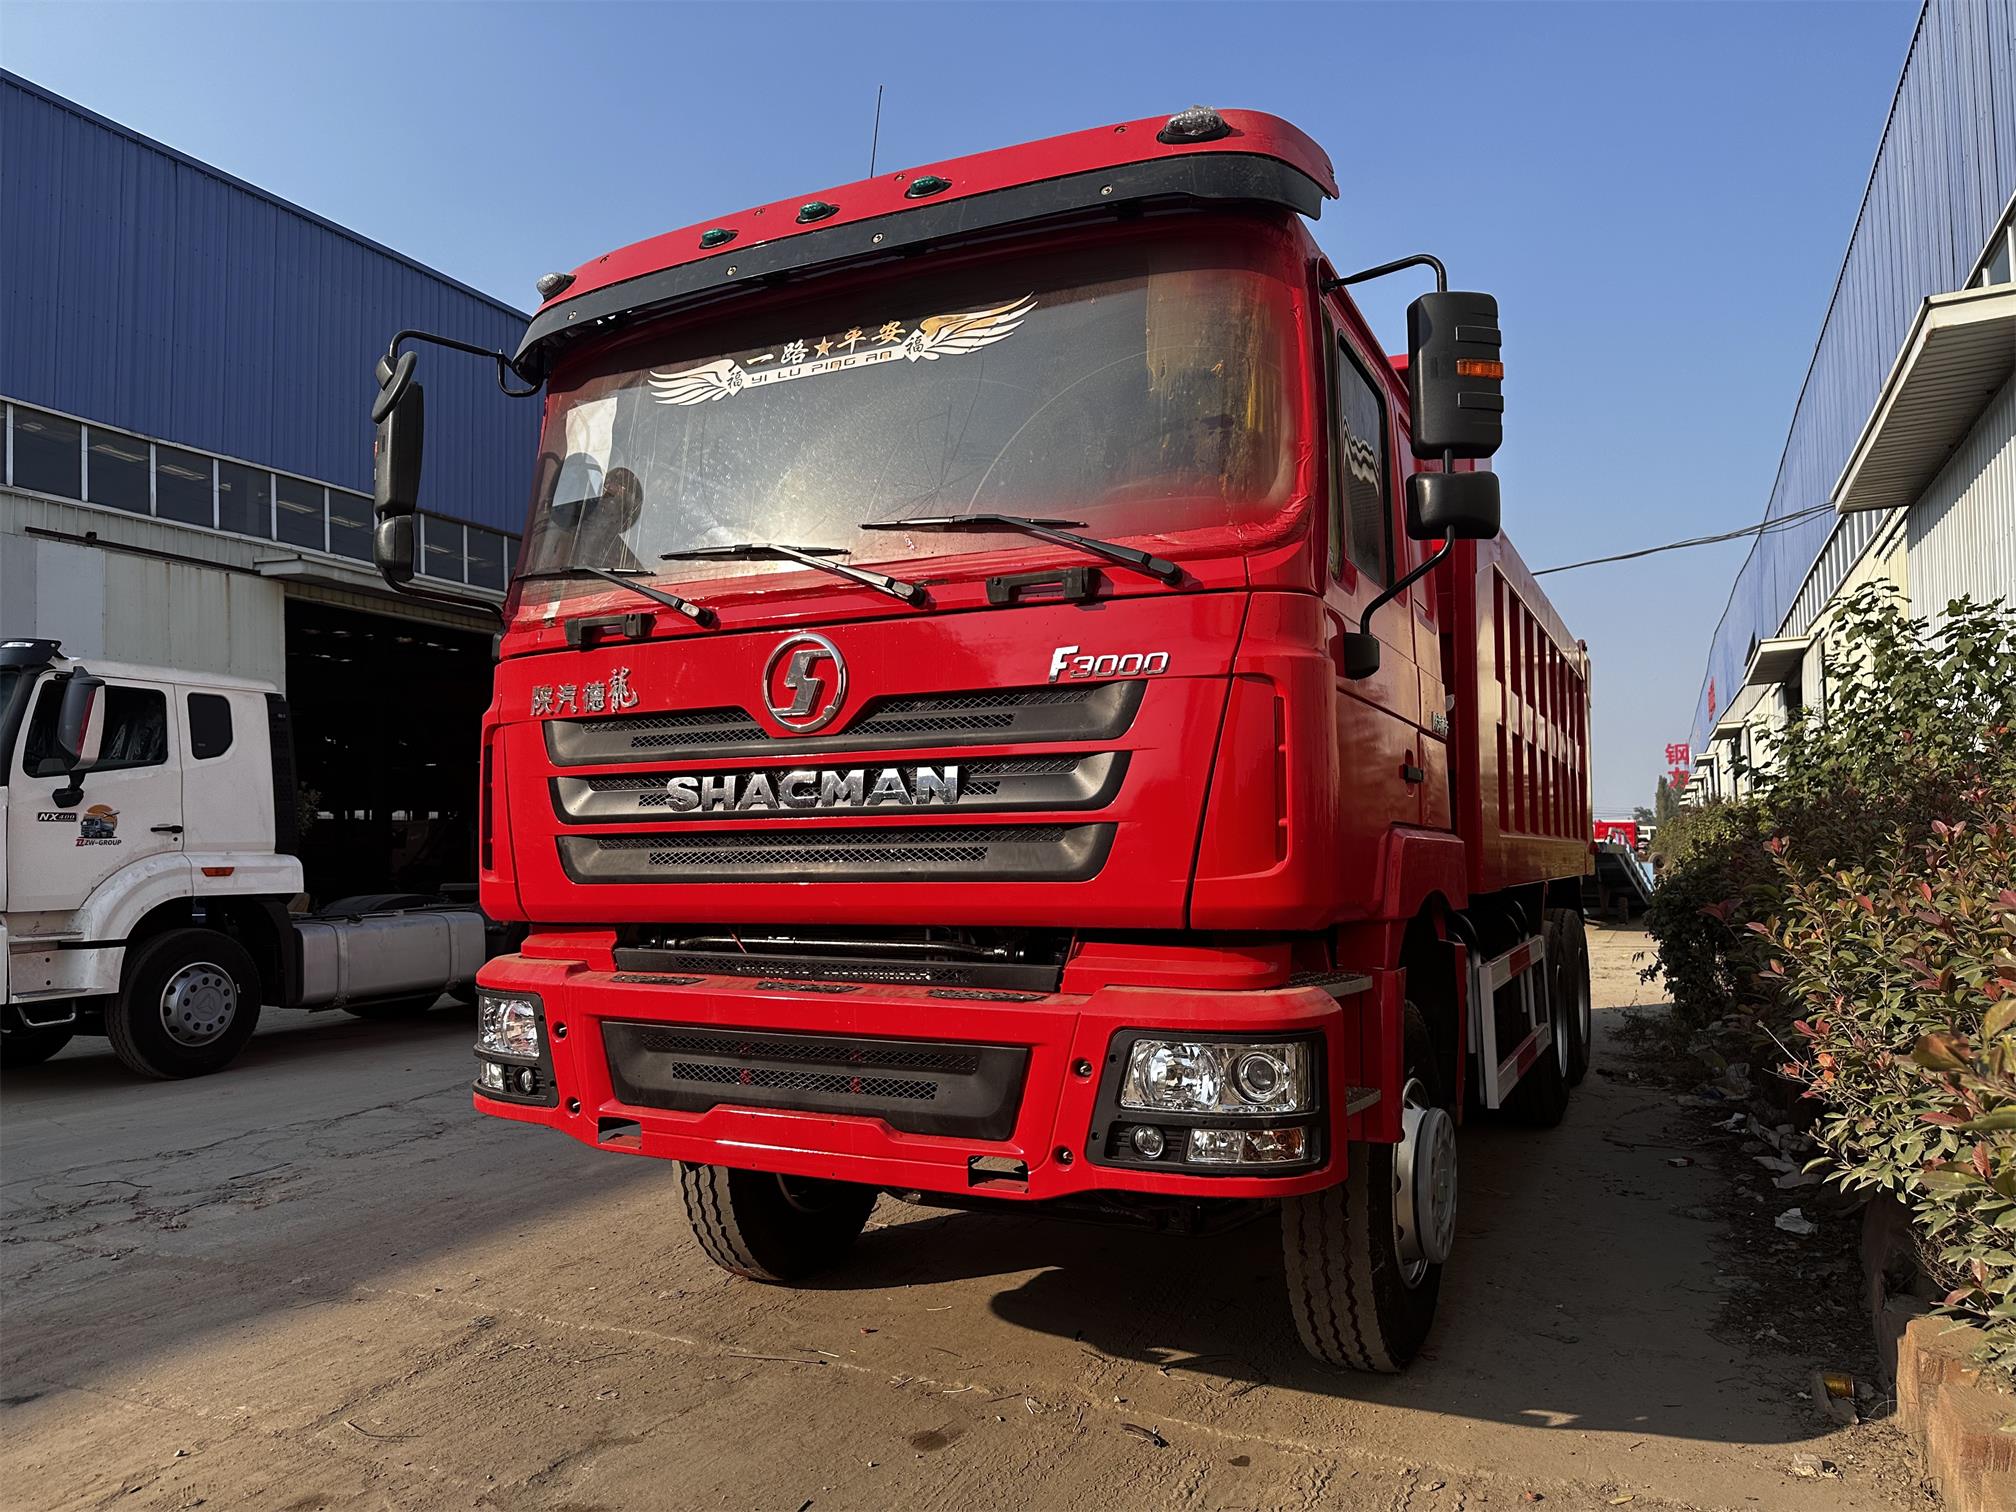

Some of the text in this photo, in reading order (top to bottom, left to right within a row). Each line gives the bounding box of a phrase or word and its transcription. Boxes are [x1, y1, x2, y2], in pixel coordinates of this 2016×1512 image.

[905, 334, 923, 355] 福
[726, 370, 743, 389] 福
[777, 367, 801, 379] LU
[1048, 645, 1169, 683] F3000
[666, 765, 959, 812] SHACMAN
